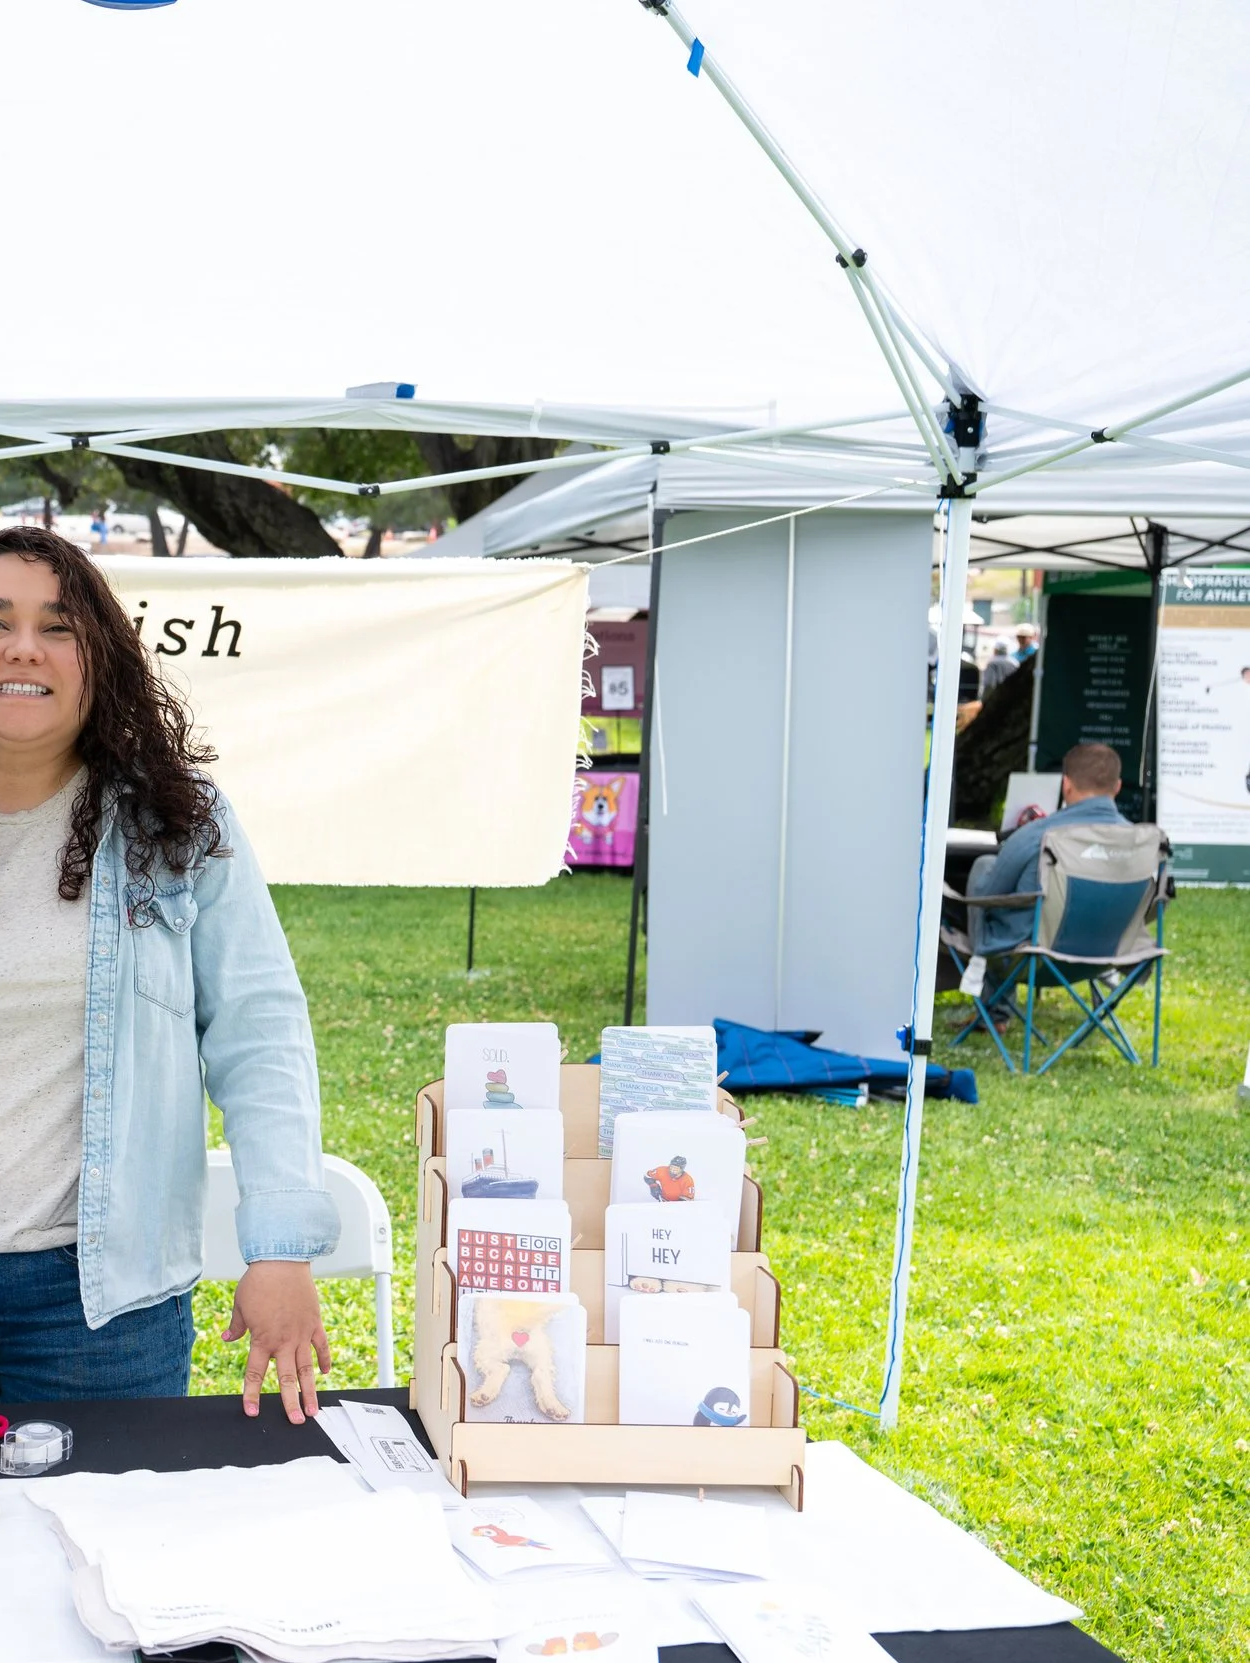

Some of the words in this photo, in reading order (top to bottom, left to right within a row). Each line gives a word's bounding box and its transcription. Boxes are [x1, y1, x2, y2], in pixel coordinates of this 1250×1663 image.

[1176, 589, 1203, 602] FOR
[652, 1228, 671, 1240] HEY
[461, 1246, 557, 1265] BECAUSE
[652, 1247, 681, 1265] HEY
[460, 1274, 557, 1292] AWESOME
